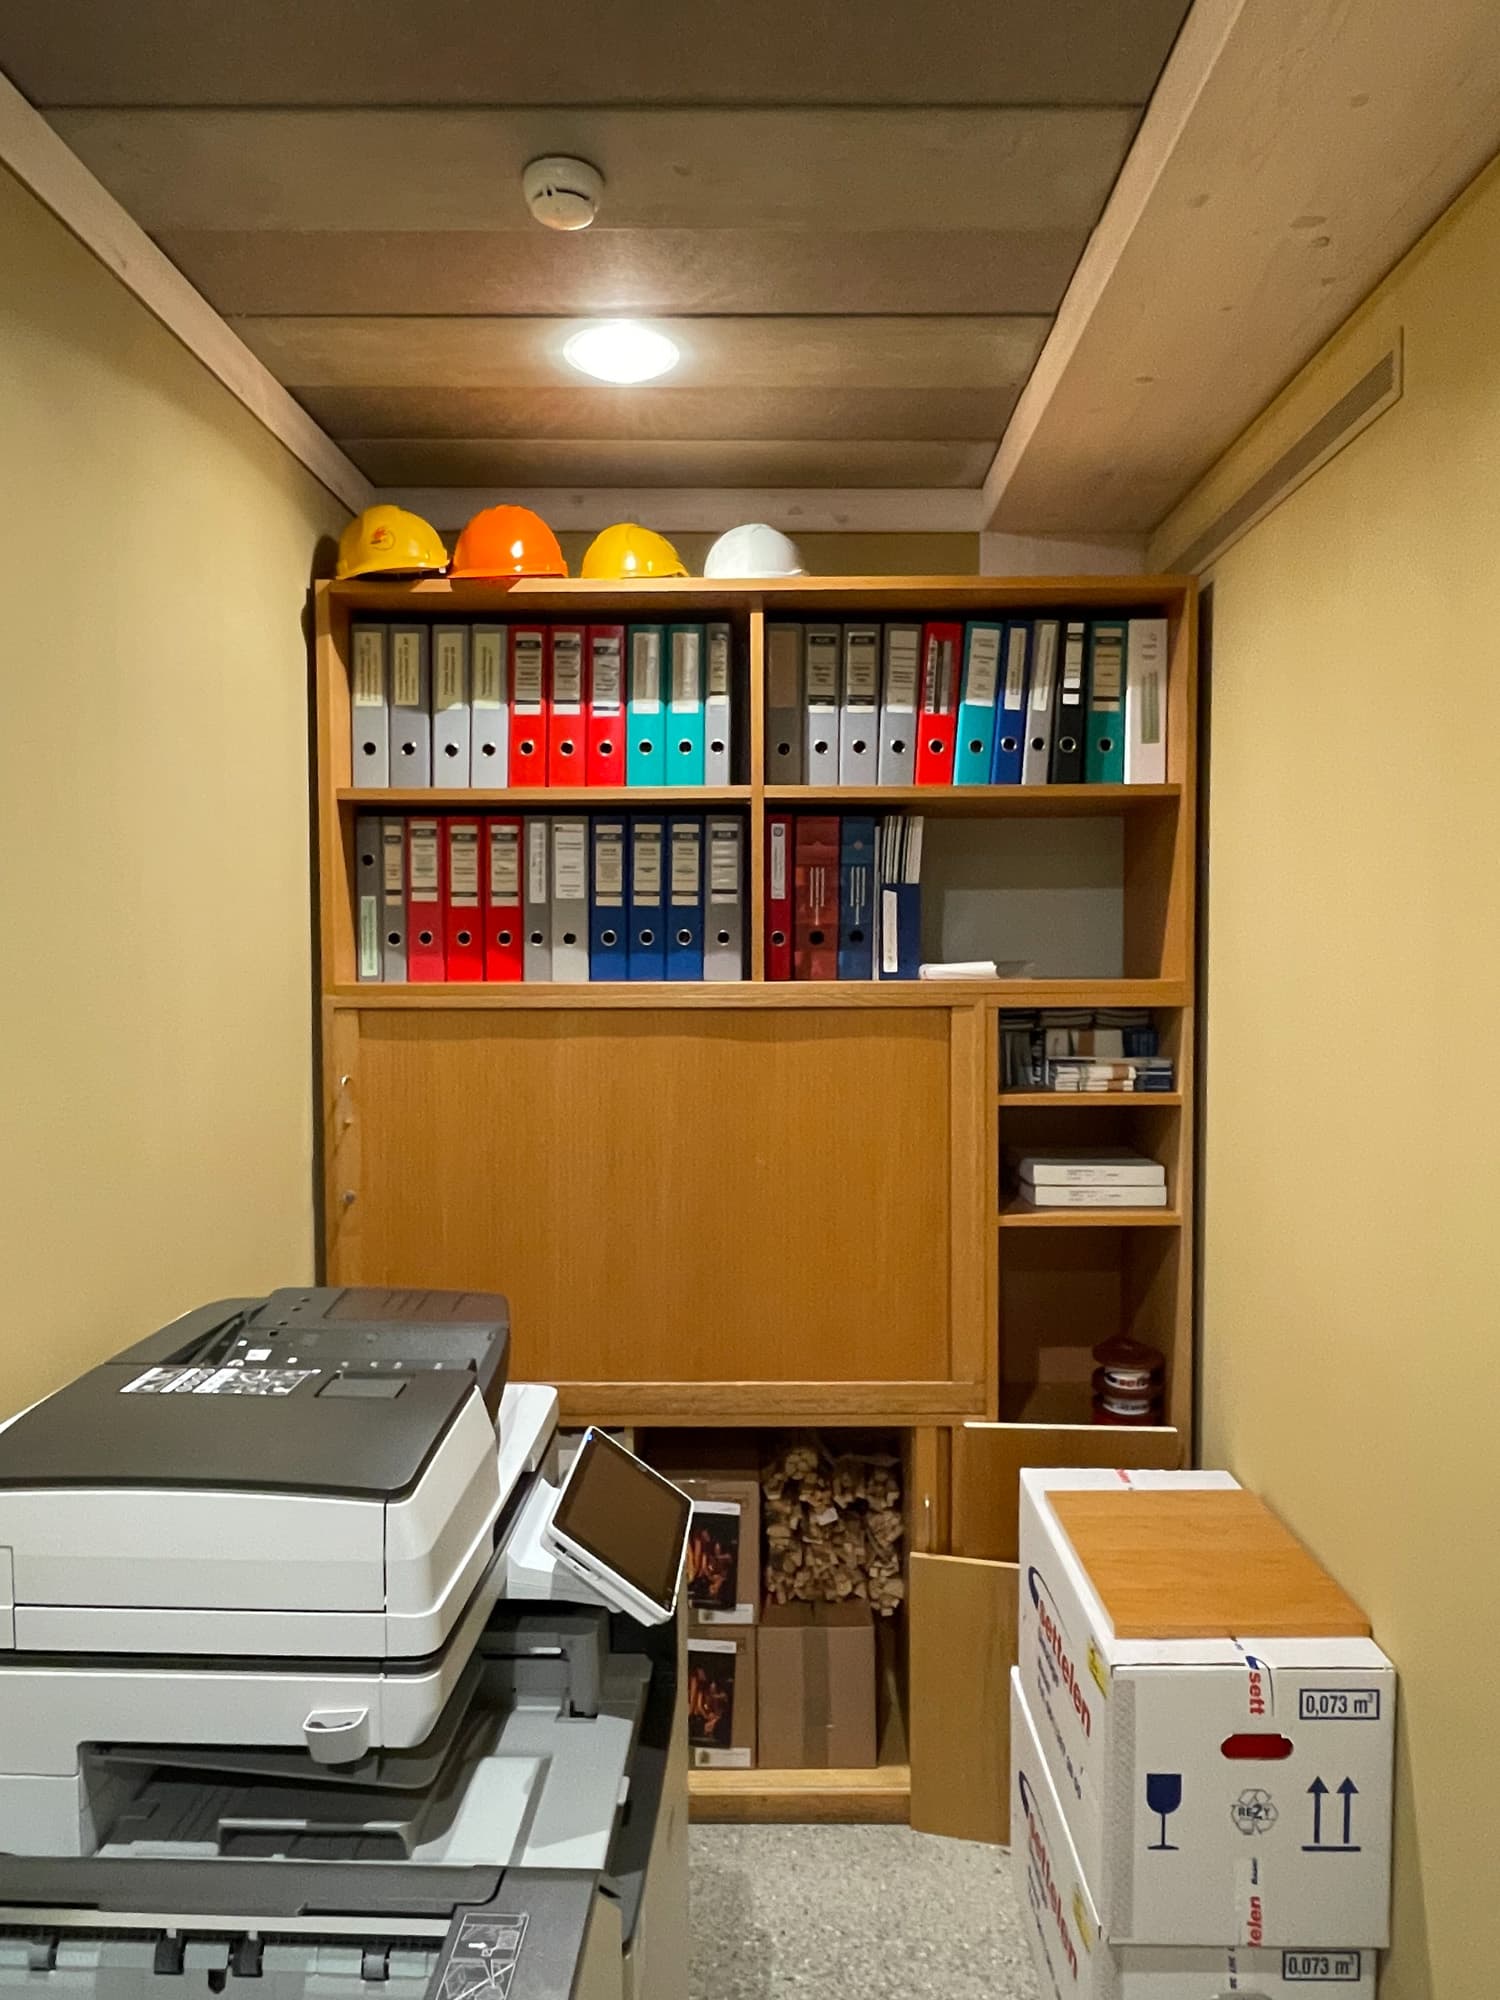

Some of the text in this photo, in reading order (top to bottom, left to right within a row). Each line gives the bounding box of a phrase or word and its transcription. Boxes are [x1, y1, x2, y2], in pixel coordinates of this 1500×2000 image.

[1038, 1599, 1091, 1738] settelen
[1249, 1671, 1265, 1716] sett
[1305, 1695, 1348, 1717] 0,073
